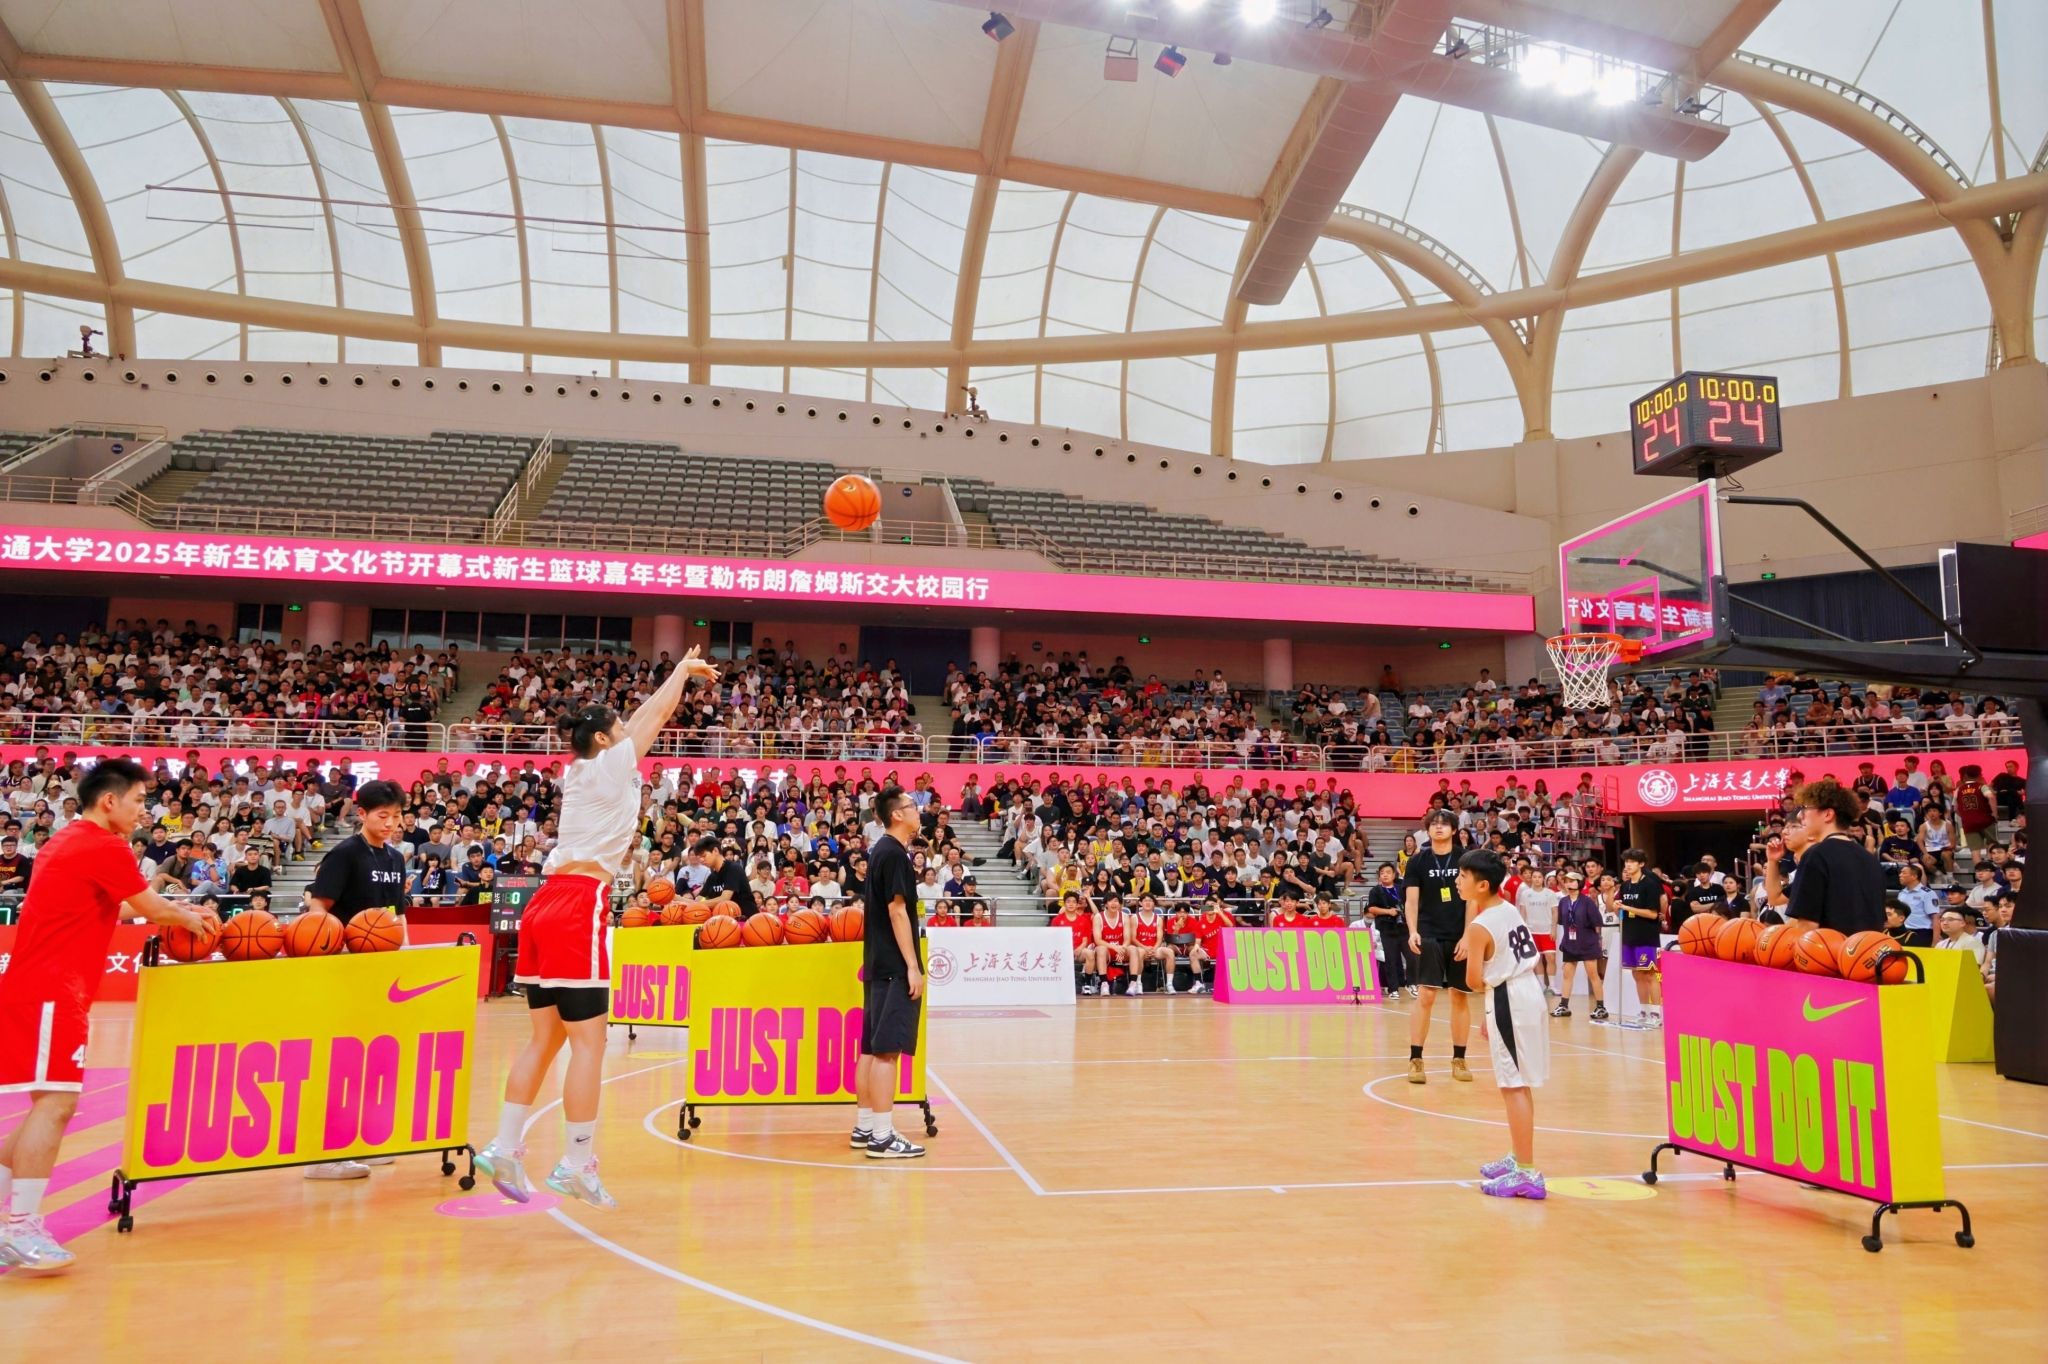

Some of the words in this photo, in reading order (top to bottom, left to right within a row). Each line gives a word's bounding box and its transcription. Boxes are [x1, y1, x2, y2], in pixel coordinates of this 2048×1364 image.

[1637, 382, 1688, 425] 10:00.0
[1700, 378, 1776, 404] 10:00.0
[1642, 407, 1681, 462] 24
[1709, 401, 1766, 445] 24
[1228, 930, 1300, 992] JUST
[1303, 930, 1347, 992] DO
[1345, 930, 1375, 991] IT
[613, 964, 669, 1021] JUST
[673, 965, 690, 1021] D
[694, 1007, 804, 1096] JUST
[143, 1038, 313, 1167] JUST
[323, 1034, 400, 1151] DO
[411, 1030, 465, 1142] IT
[1670, 1033, 1757, 1158] JUST
[1767, 1048, 1825, 1173] DO
[1833, 1058, 1877, 1189] IT
